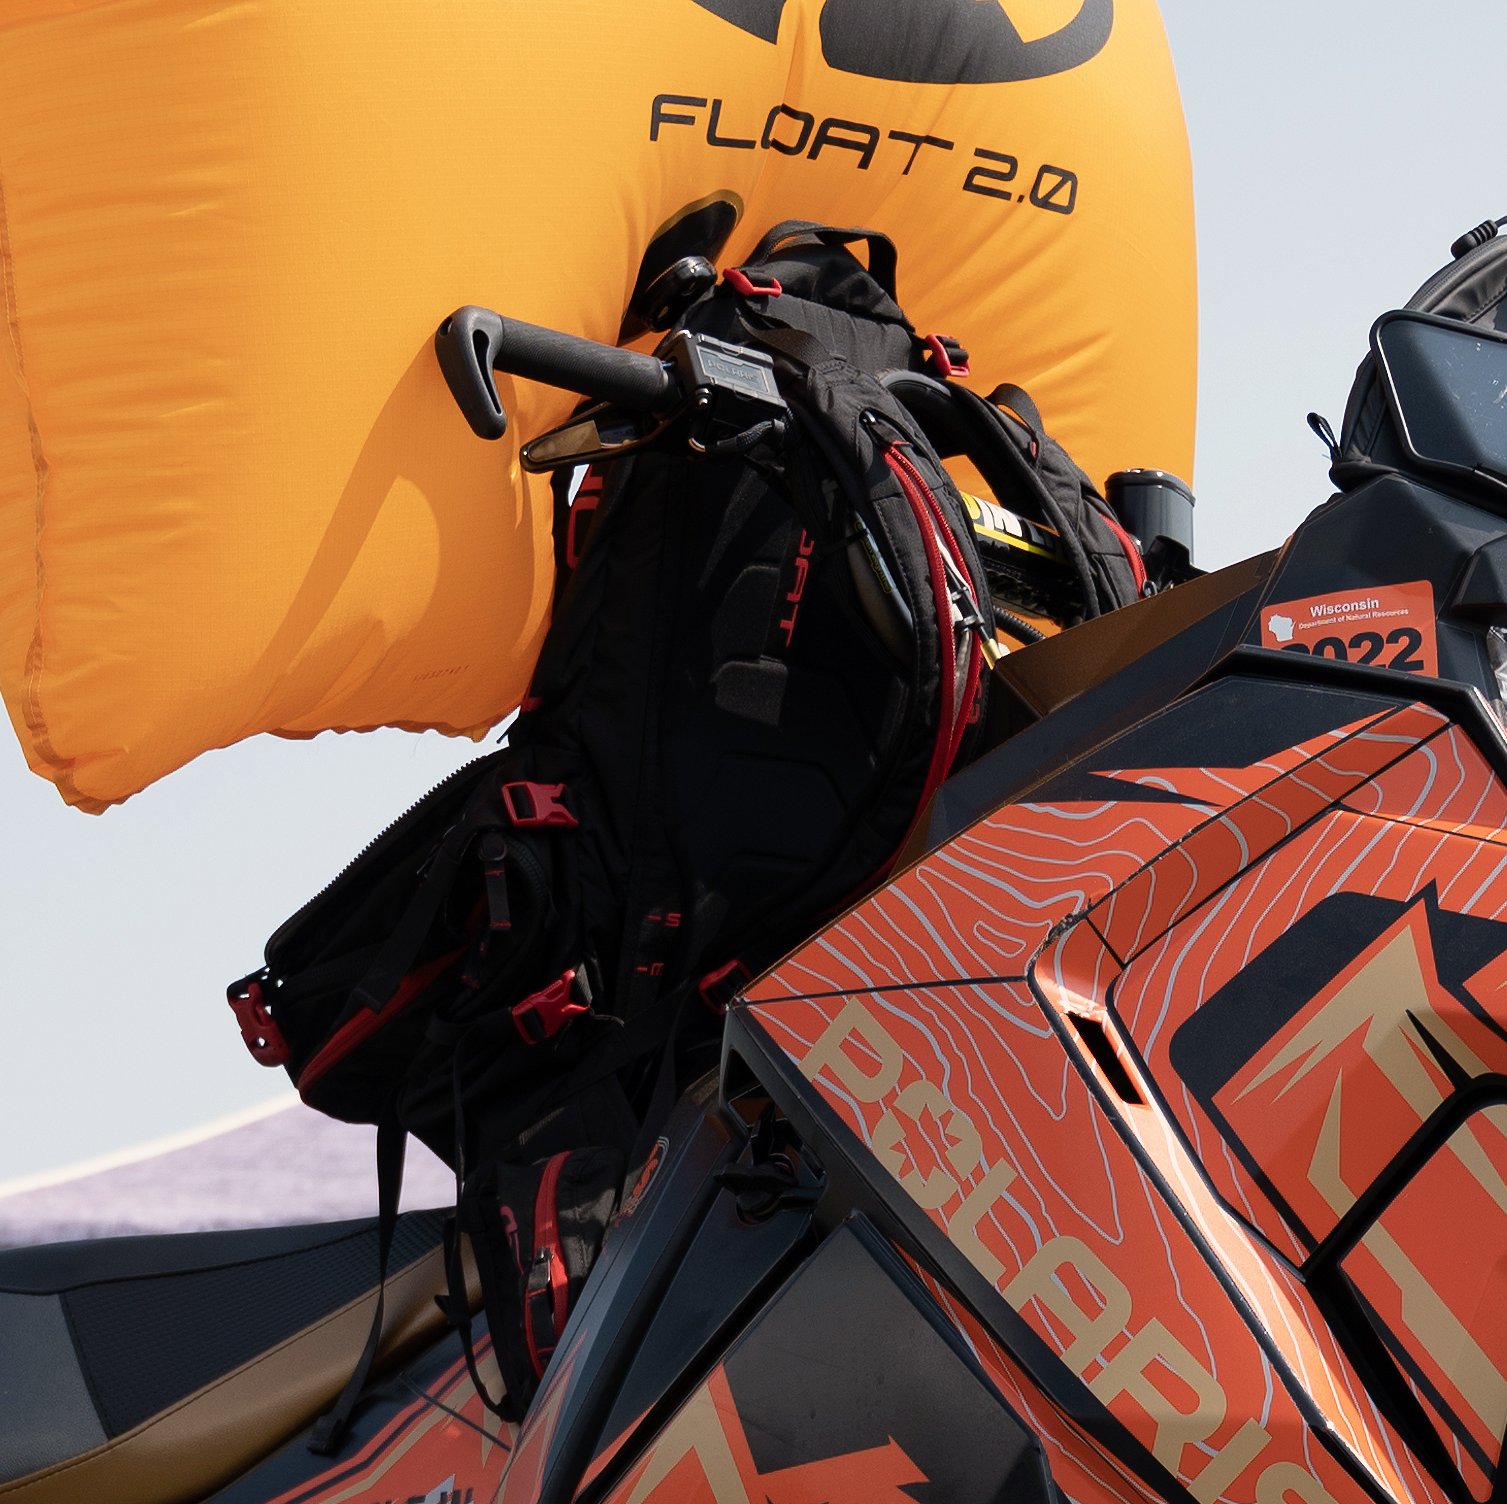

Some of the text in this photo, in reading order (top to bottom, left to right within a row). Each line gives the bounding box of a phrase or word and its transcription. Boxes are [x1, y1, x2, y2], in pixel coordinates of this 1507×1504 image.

[649, 93, 1078, 216] FLOAT 2.0
[1298, 616, 1337, 630] Department
[1346, 611, 1371, 622] Natural
[1372, 607, 1409, 619] Resources
[1310, 598, 1380, 617] Wisconsin
[1280, 627, 1425, 672] 022
